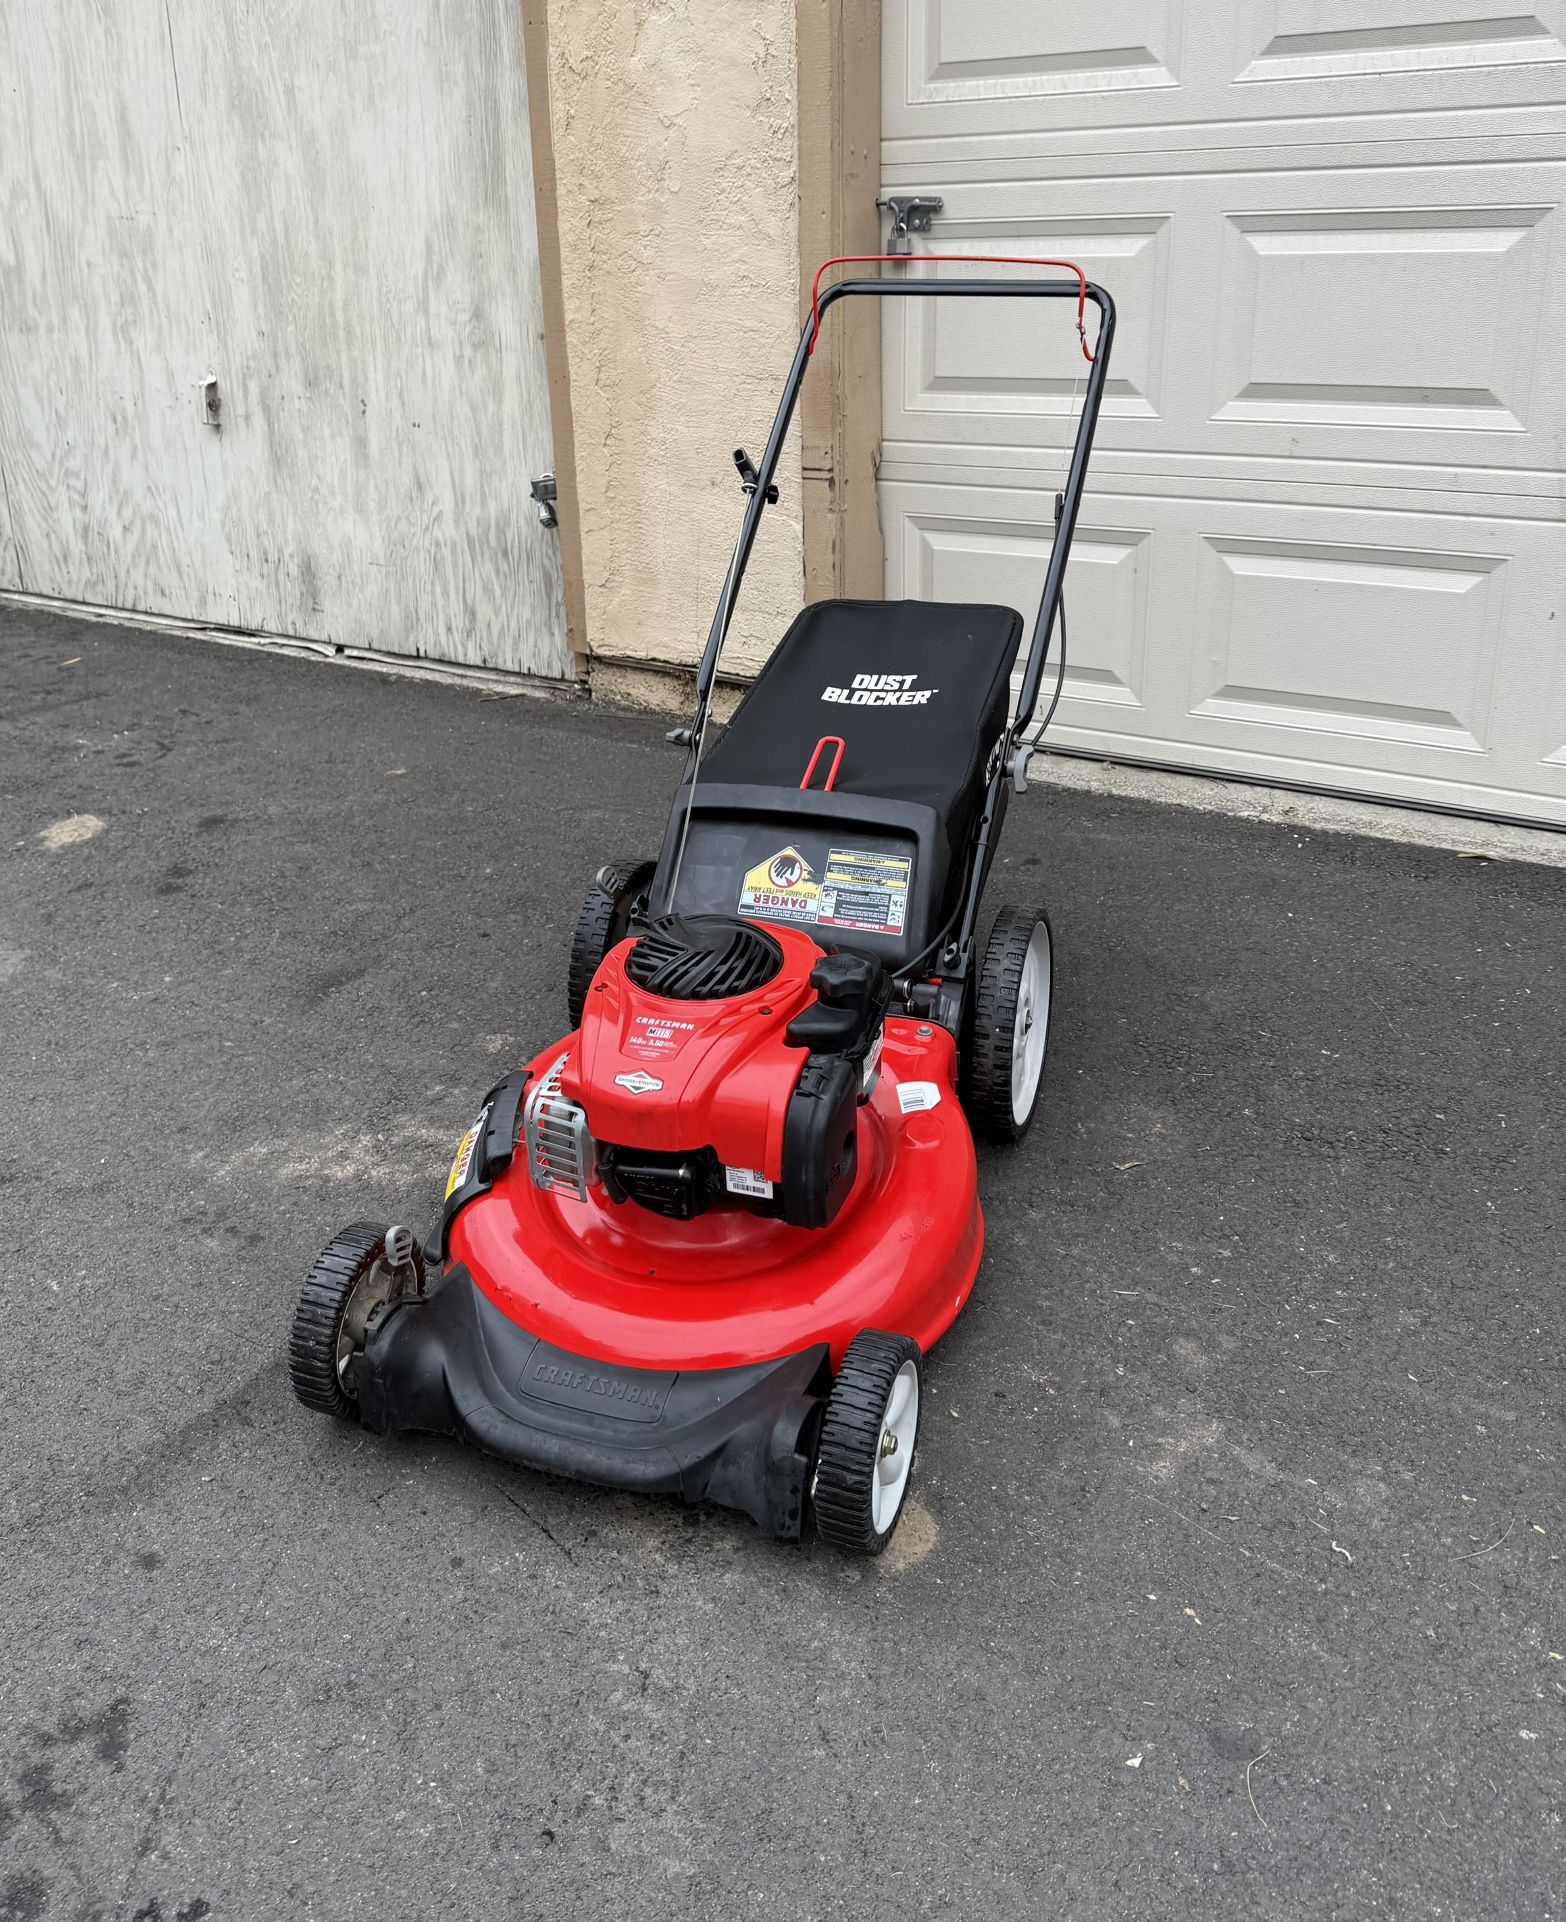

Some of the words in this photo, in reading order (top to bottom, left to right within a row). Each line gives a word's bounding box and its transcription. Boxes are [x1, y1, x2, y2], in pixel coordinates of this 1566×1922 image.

[851, 673, 918, 690] DUST
[753, 893, 808, 910] DANGER
[635, 1016, 695, 1030] CRAFTSMAN
[457, 1131, 478, 1177] DANGER
